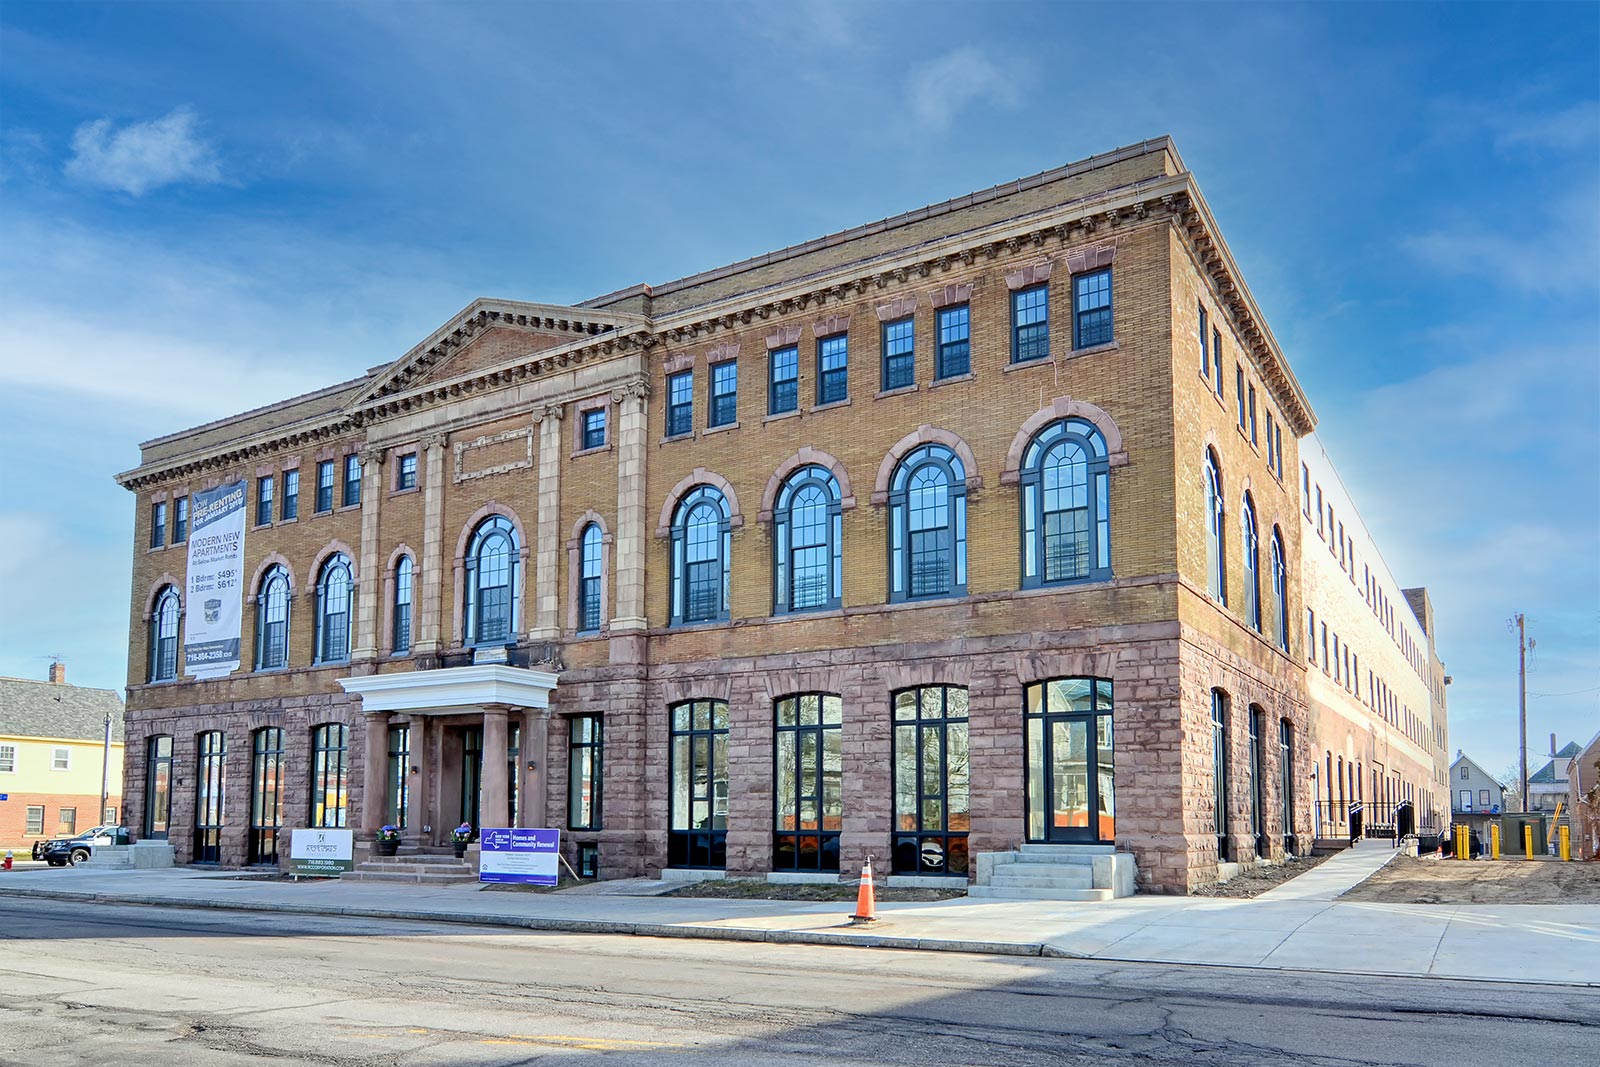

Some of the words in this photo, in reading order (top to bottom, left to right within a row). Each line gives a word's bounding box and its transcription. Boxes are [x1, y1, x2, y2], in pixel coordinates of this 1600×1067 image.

[192, 535, 221, 549] MODERN
[223, 531, 240, 543] NEW
[192, 541, 238, 559] APARTMENTS
